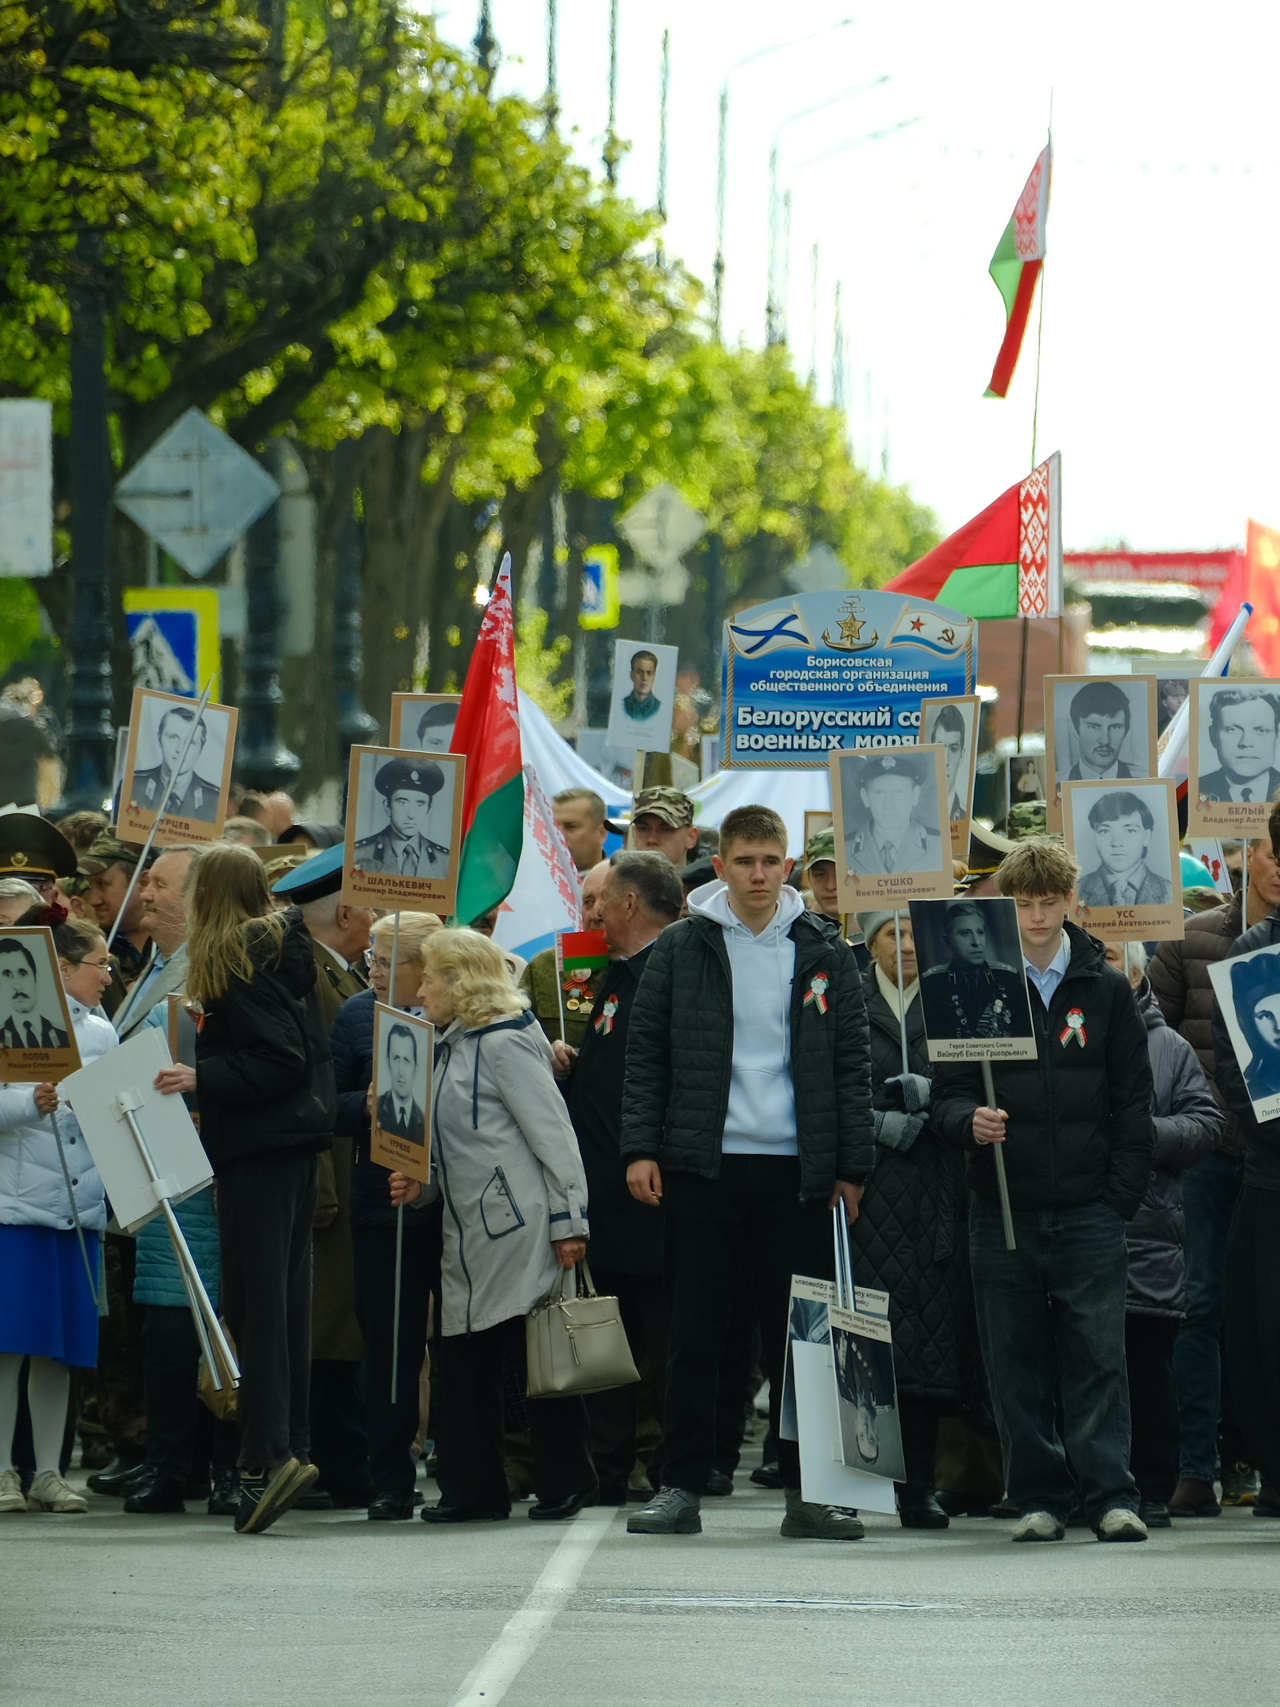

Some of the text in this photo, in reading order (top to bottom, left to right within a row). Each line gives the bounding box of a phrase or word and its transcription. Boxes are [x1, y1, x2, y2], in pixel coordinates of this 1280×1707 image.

[806, 656, 893, 668] Борисовская
[770, 669, 930, 681] городская организация
[750, 680, 948, 693] общественного объединения
[736, 706, 921, 731] Белорусский со
[736, 734, 843, 750] военных
[1228, 806, 1264, 816] БЕЛЫЙ
[1203, 816, 1244, 824] Владимир
[368, 877, 432, 890] ШАЛЬКЕВИЧ
[877, 877, 914, 888] СУШКО
[352, 884, 446, 900] Казимир Владимирович
[886, 886, 936, 896] Николаевич
[1116, 910, 1135, 918] УСС
[1082, 920, 1116, 928] Валерий
